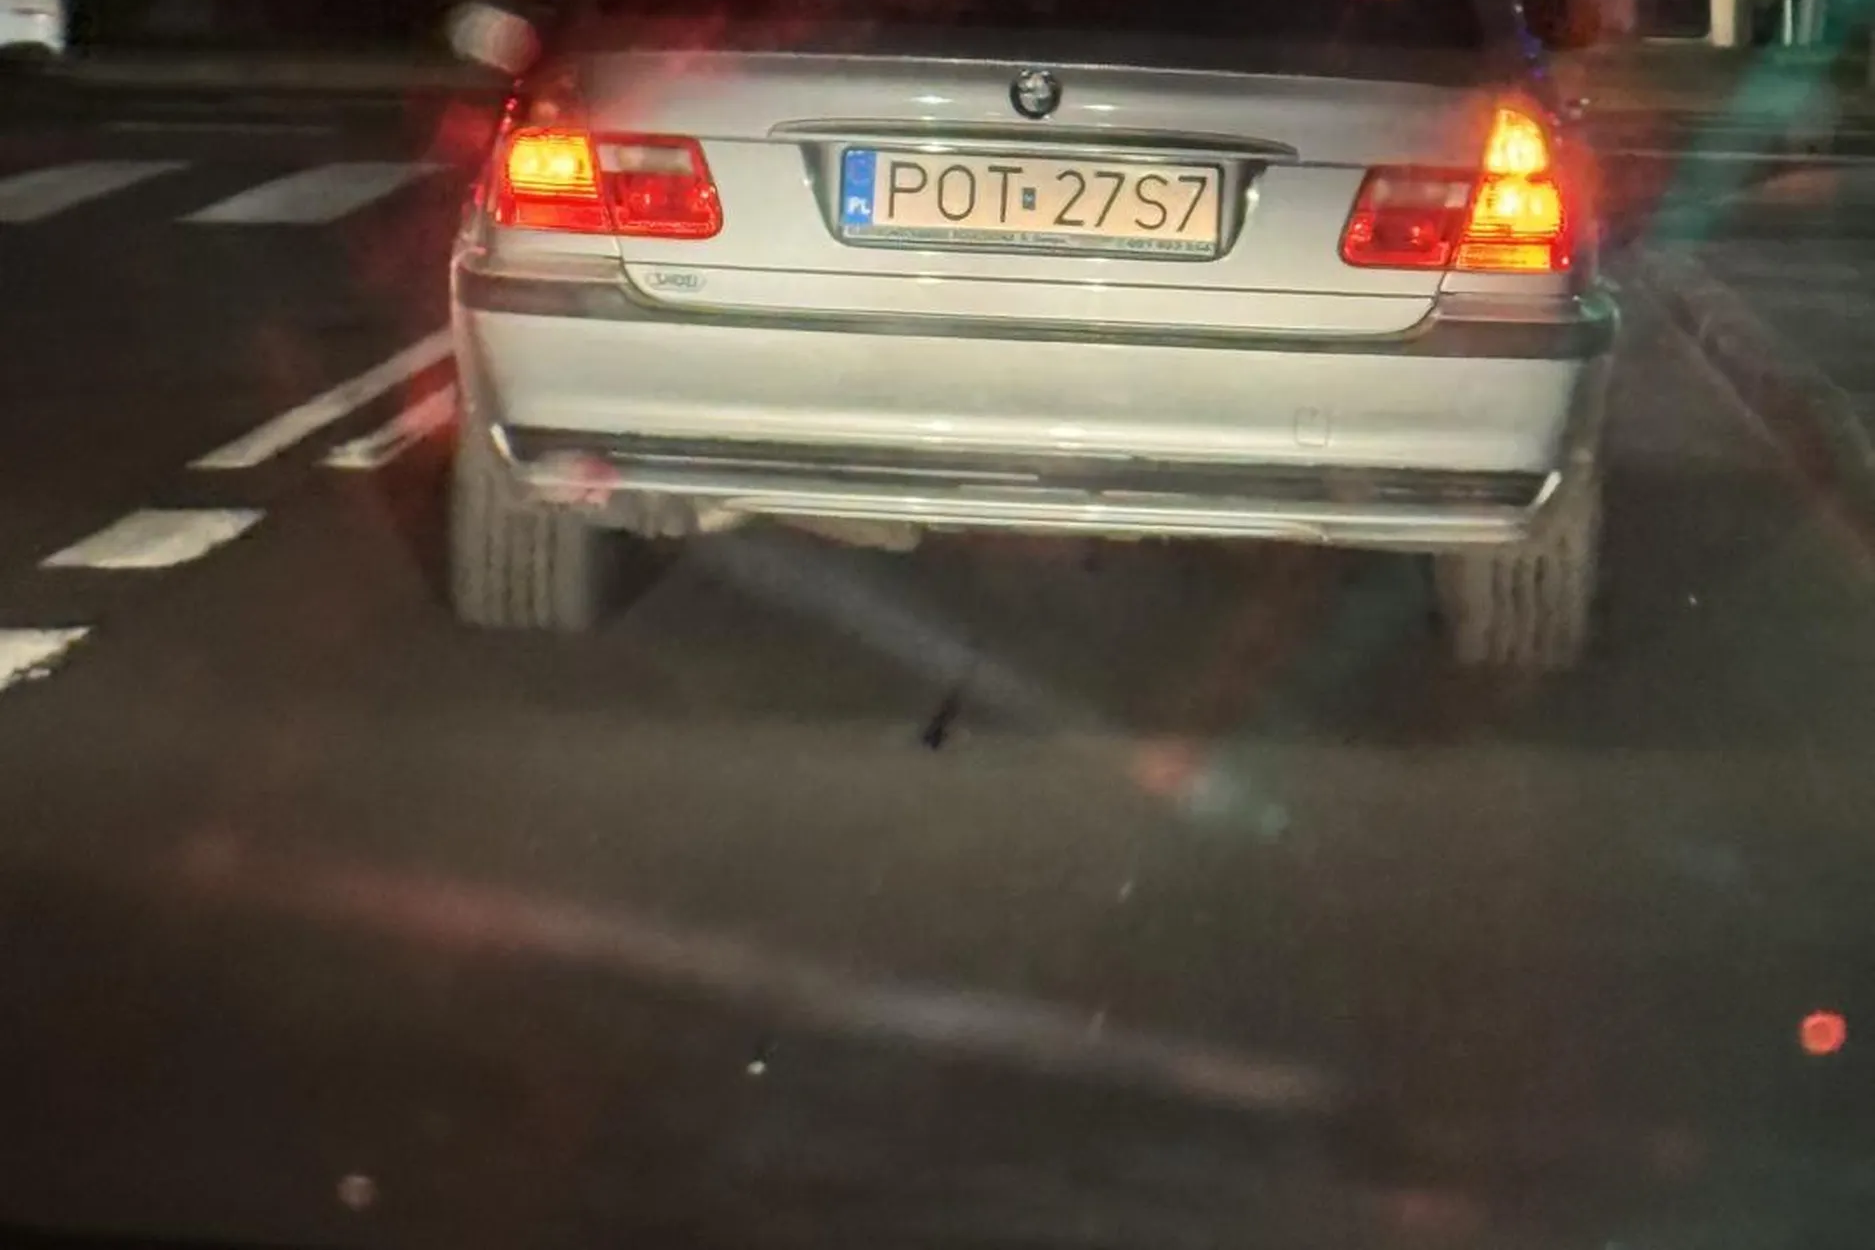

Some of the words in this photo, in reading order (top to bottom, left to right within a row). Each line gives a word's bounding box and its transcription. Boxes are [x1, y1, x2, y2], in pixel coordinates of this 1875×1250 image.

[846, 196, 871, 215] PL
[887, 160, 1024, 224] POT
[1053, 169, 1209, 233] 27S7
